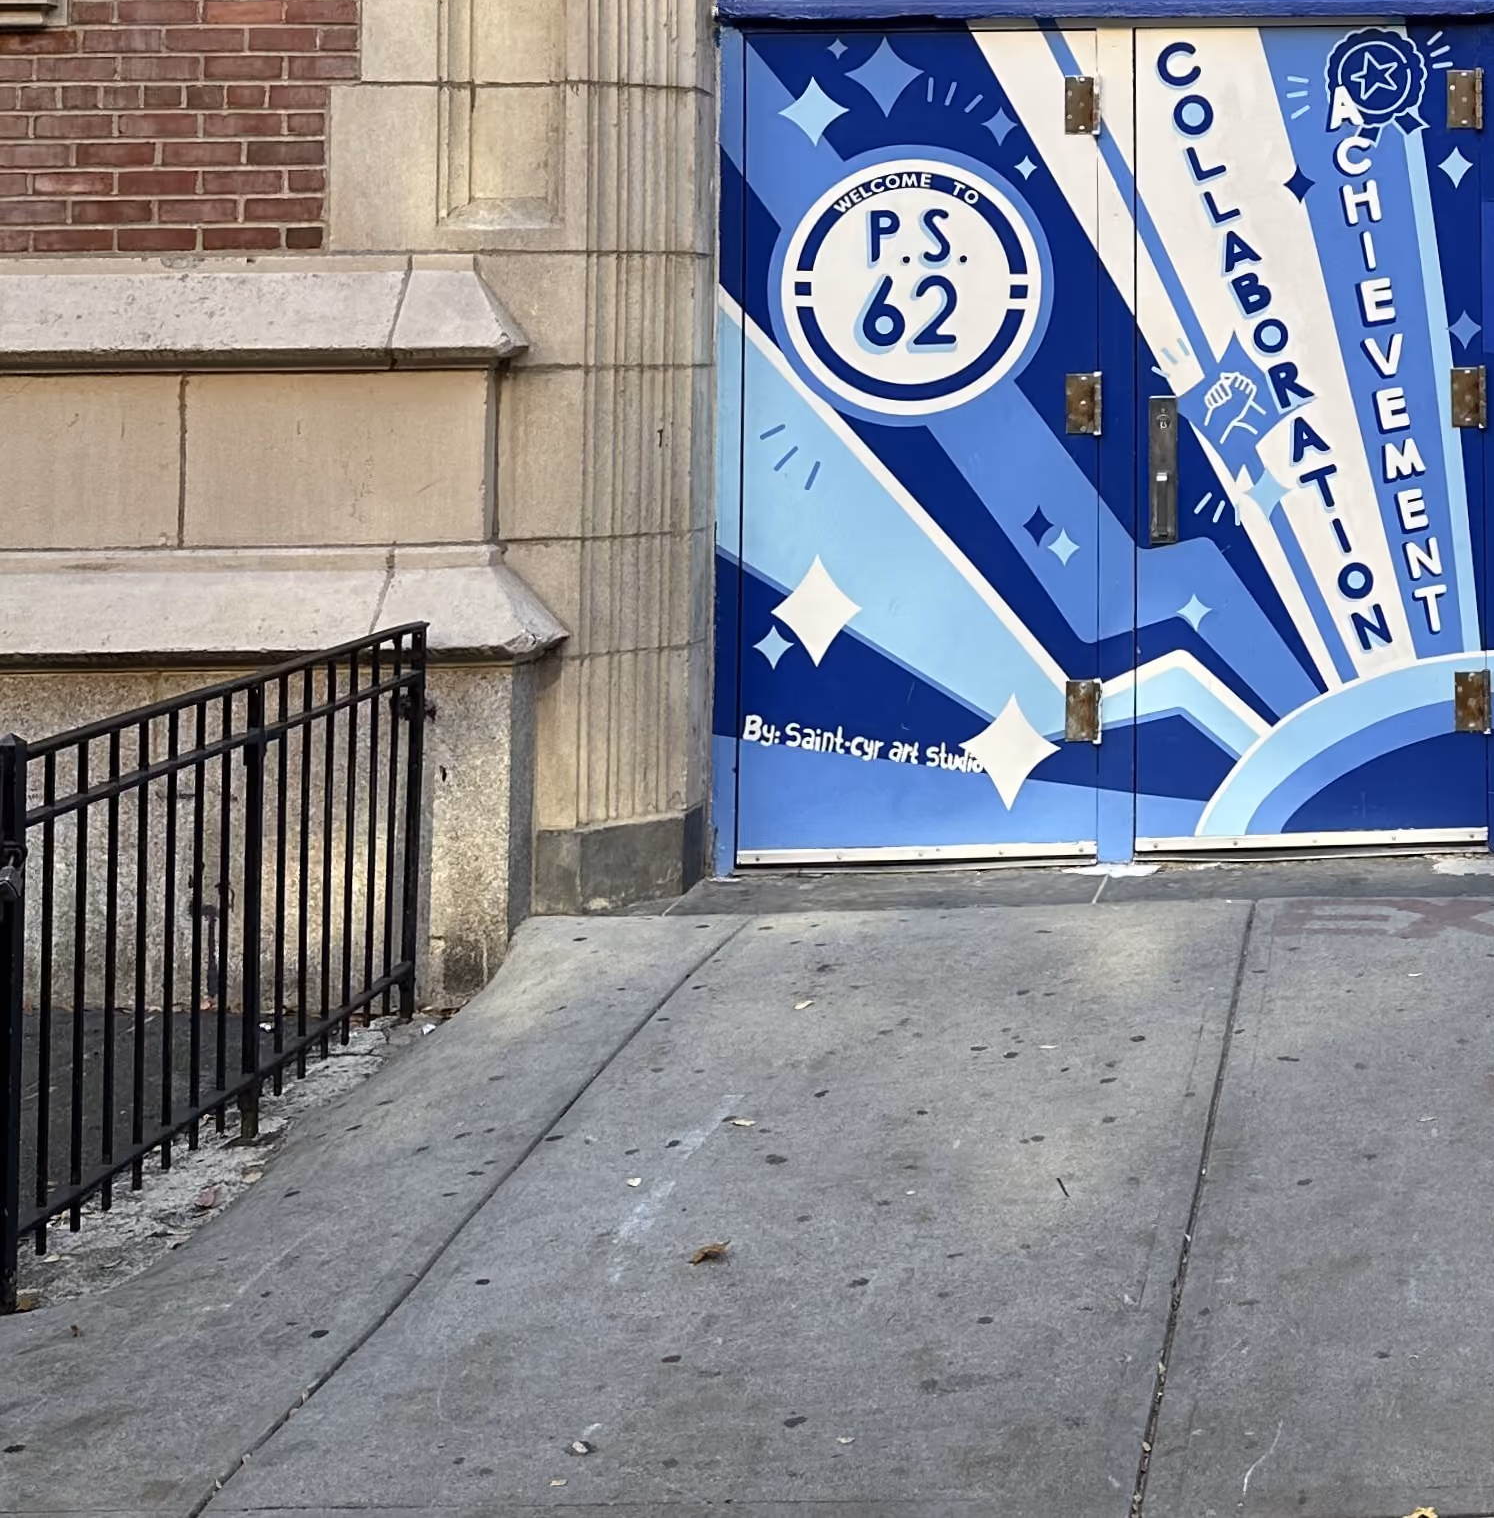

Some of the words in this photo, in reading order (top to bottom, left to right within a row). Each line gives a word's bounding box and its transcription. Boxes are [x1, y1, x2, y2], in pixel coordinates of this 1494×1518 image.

[833, 173, 933, 214] WELCOME
[951, 181, 980, 205] TO
[866, 208, 968, 268] P.S.
[856, 274, 958, 353] 62
[1156, 41, 1394, 651] COLLABORATION
[1326, 84, 1447, 634] ACHIEVEMENT
[742, 714, 781, 746] By:
[785, 722, 884, 761] Saint-cyr
[888, 741, 919, 765] art
